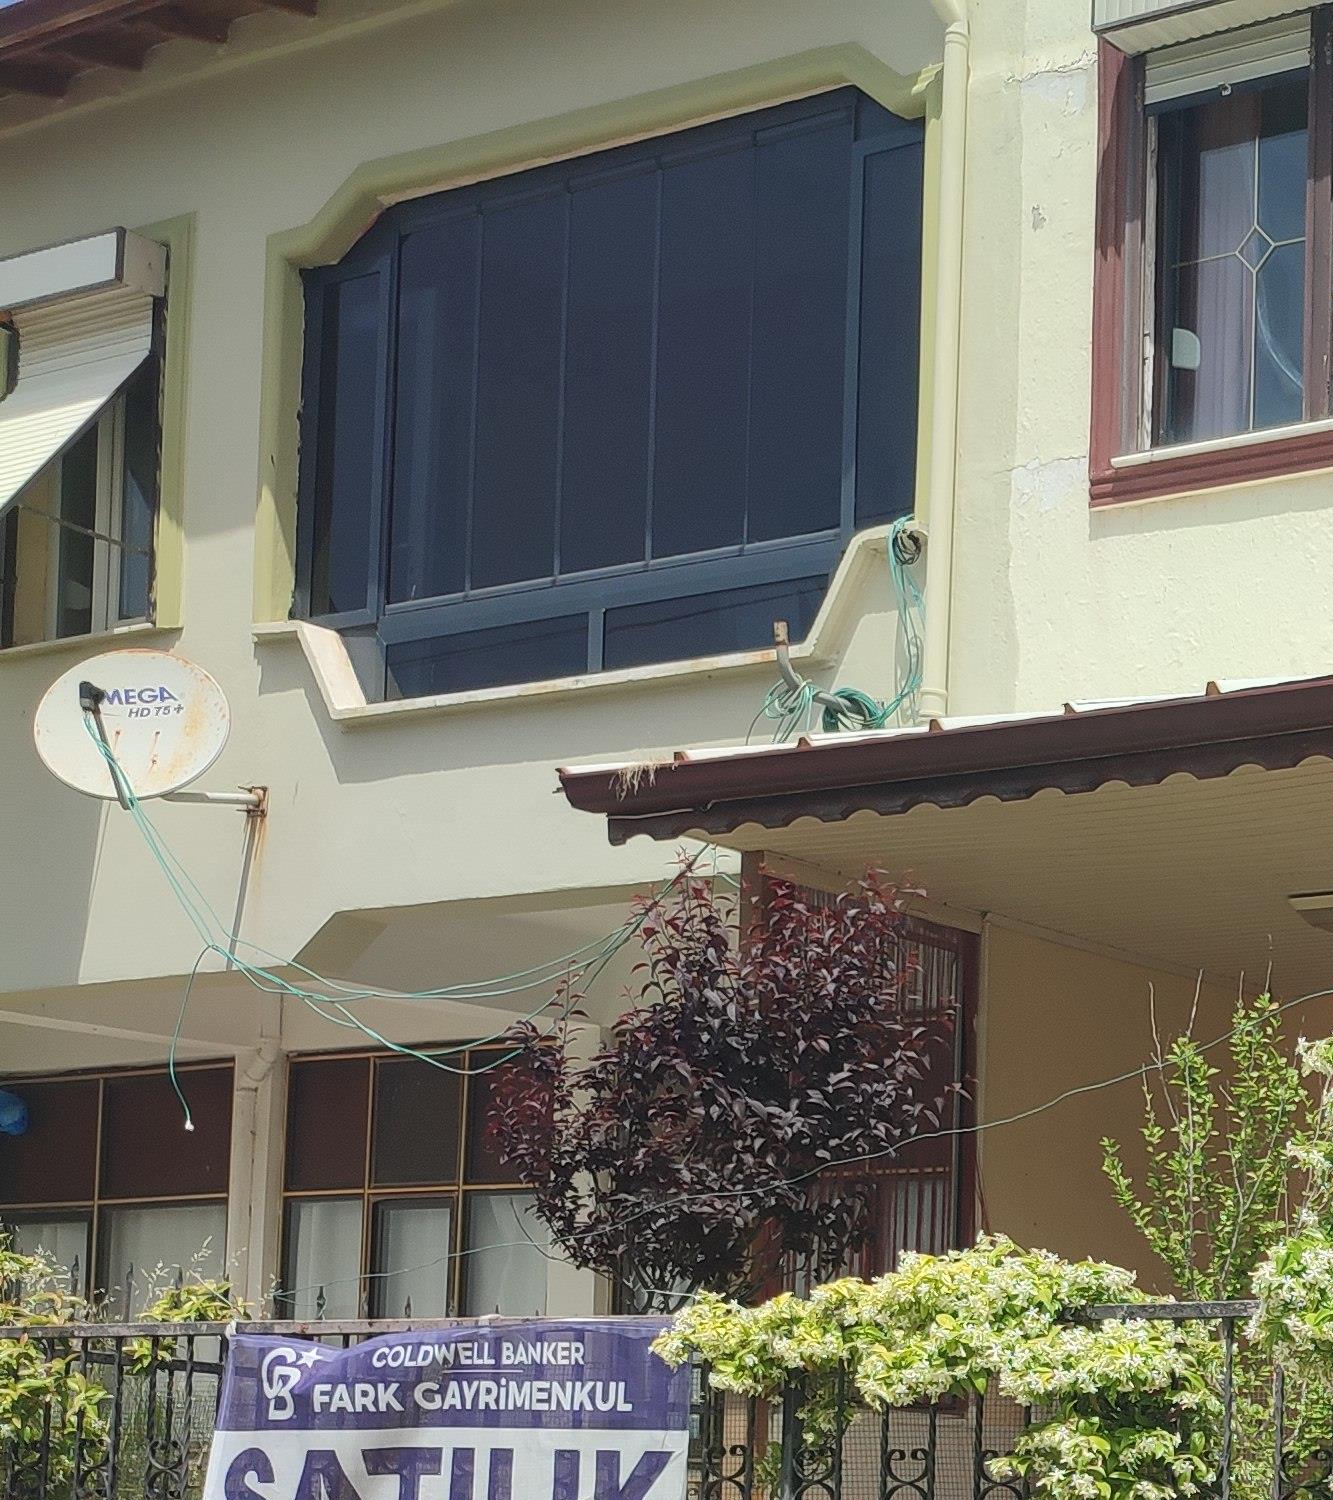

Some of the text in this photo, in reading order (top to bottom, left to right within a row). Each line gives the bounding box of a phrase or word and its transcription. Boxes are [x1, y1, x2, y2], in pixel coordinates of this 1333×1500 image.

[128, 707, 151, 718] HD
[372, 1341, 586, 1368] COLDWELL BANKER
[312, 1378, 634, 1413] FARK GAYRİMENKUL
